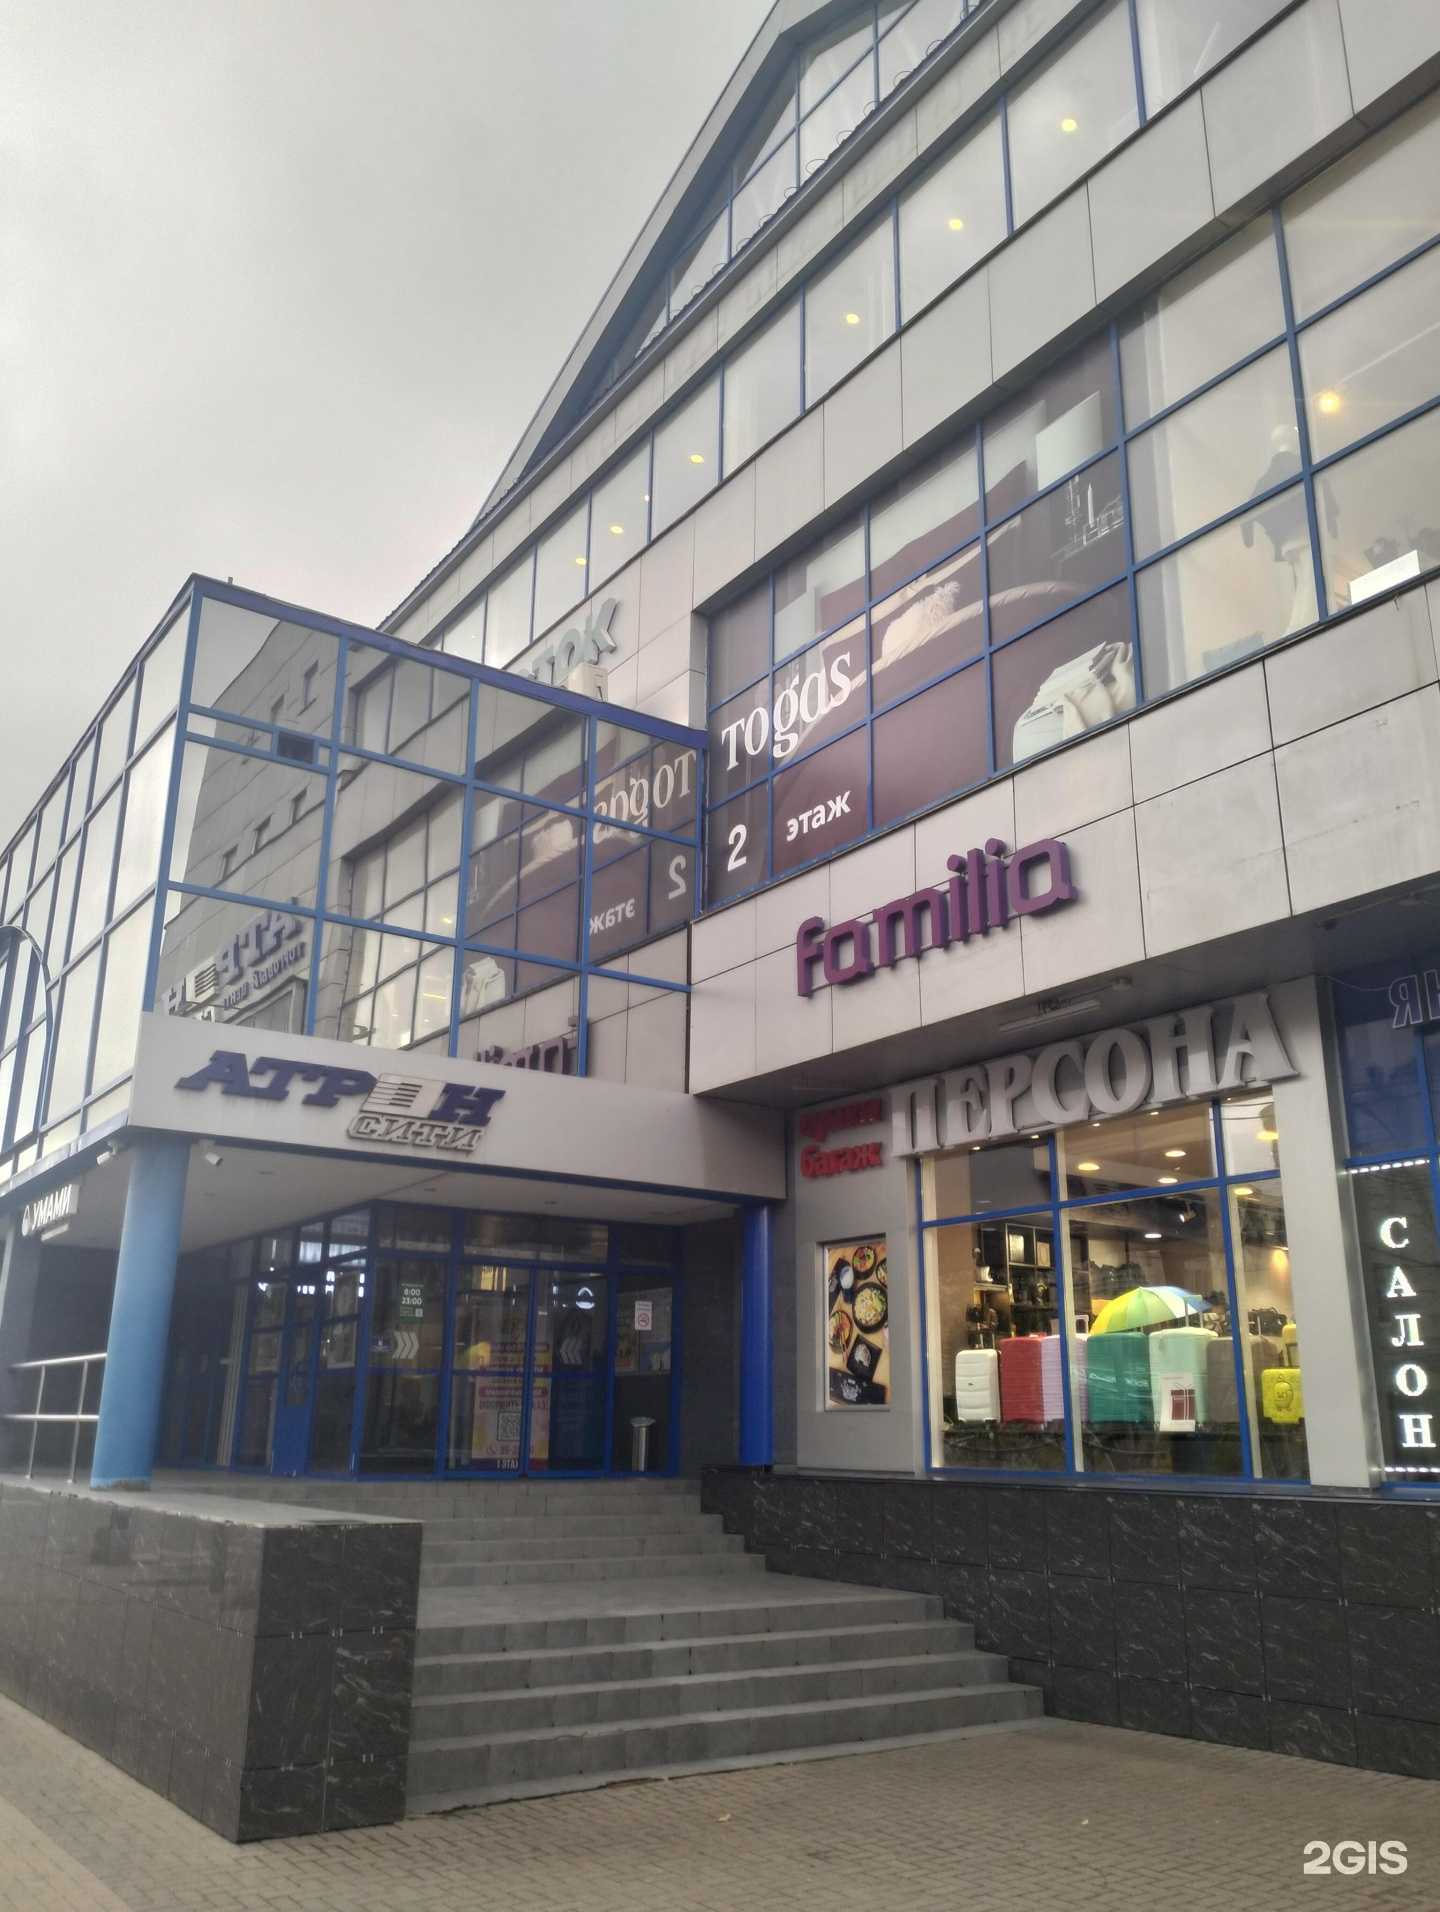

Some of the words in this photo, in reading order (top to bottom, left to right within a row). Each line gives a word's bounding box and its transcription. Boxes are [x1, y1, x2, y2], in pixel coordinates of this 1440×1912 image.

[727, 823, 748, 872] 2
[786, 790, 851, 842] этаж
[796, 837, 1076, 997] familia
[351, 1114, 484, 1151] СИТИ
[888, 992, 1299, 1157] ПЕРСОНА
[32, 1184, 72, 1230] УМАМИ
[1379, 1216, 1437, 1448] САЛОН
